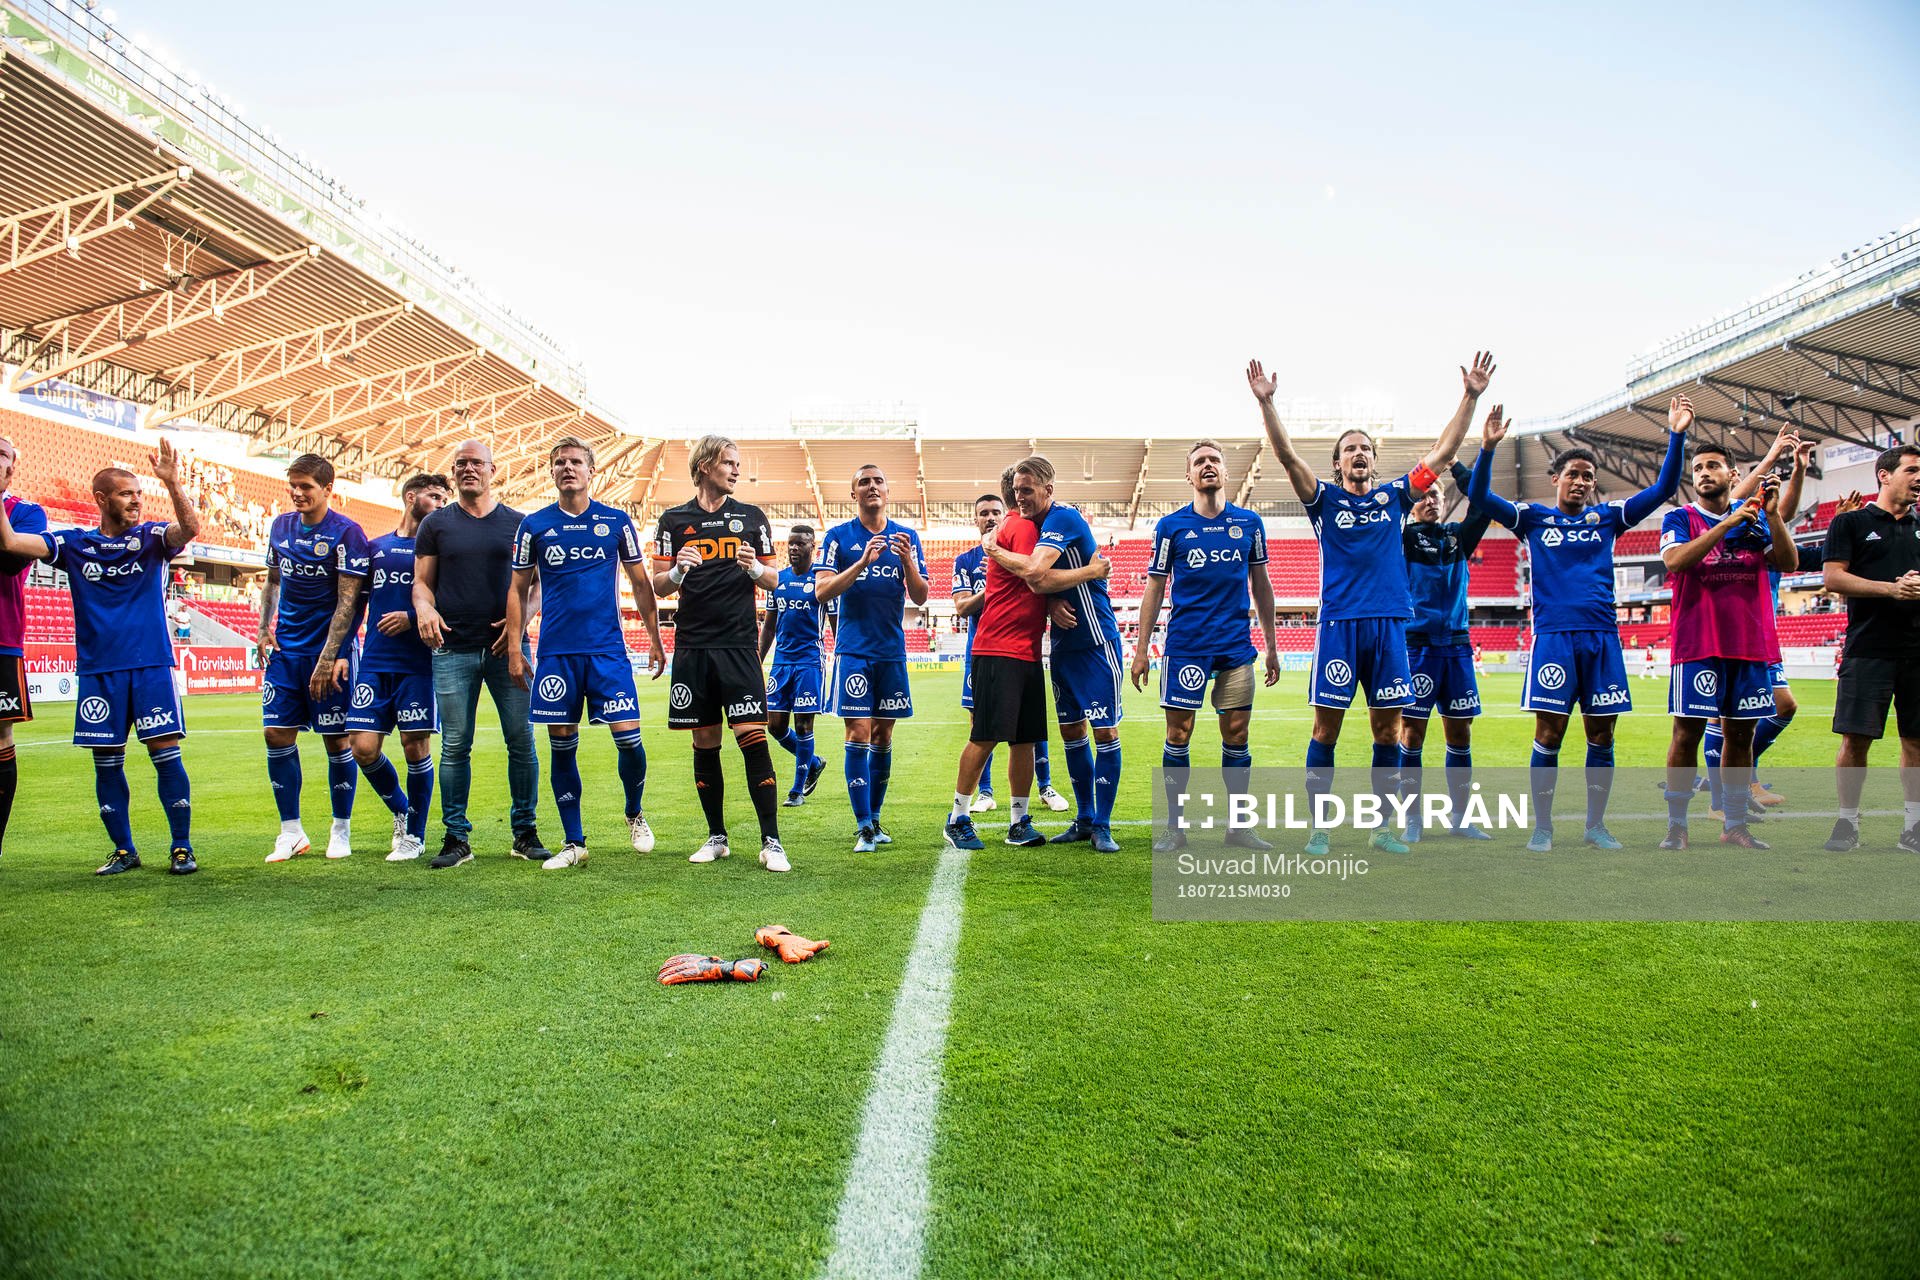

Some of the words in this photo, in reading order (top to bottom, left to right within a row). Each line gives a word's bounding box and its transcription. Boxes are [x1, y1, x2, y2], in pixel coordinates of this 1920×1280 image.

[1359, 510, 1392, 523] SCA
[1567, 529, 1602, 542] SCA
[570, 546, 606, 560] SCA
[1210, 548, 1242, 563] SCA
[106, 561, 144, 577] SCA
[295, 564, 328, 577] SCA
[872, 565, 899, 579] SCA
[788, 600, 811, 610] SCA
[198, 655, 244, 672] rörvikshus
[916, 662, 944, 670] HYLTE
[1376, 683, 1412, 701] ABAX
[1592, 690, 1630, 706] ABAX
[603, 698, 636, 715] ABAX
[794, 696, 817, 708] ABAX
[879, 697, 910, 711] ABAX
[1450, 695, 1480, 711] ABAX
[1738, 693, 1775, 711] ABAX
[398, 708, 429, 722] ABAX
[728, 701, 763, 718] ABAX
[136, 711, 174, 731] ABAX
